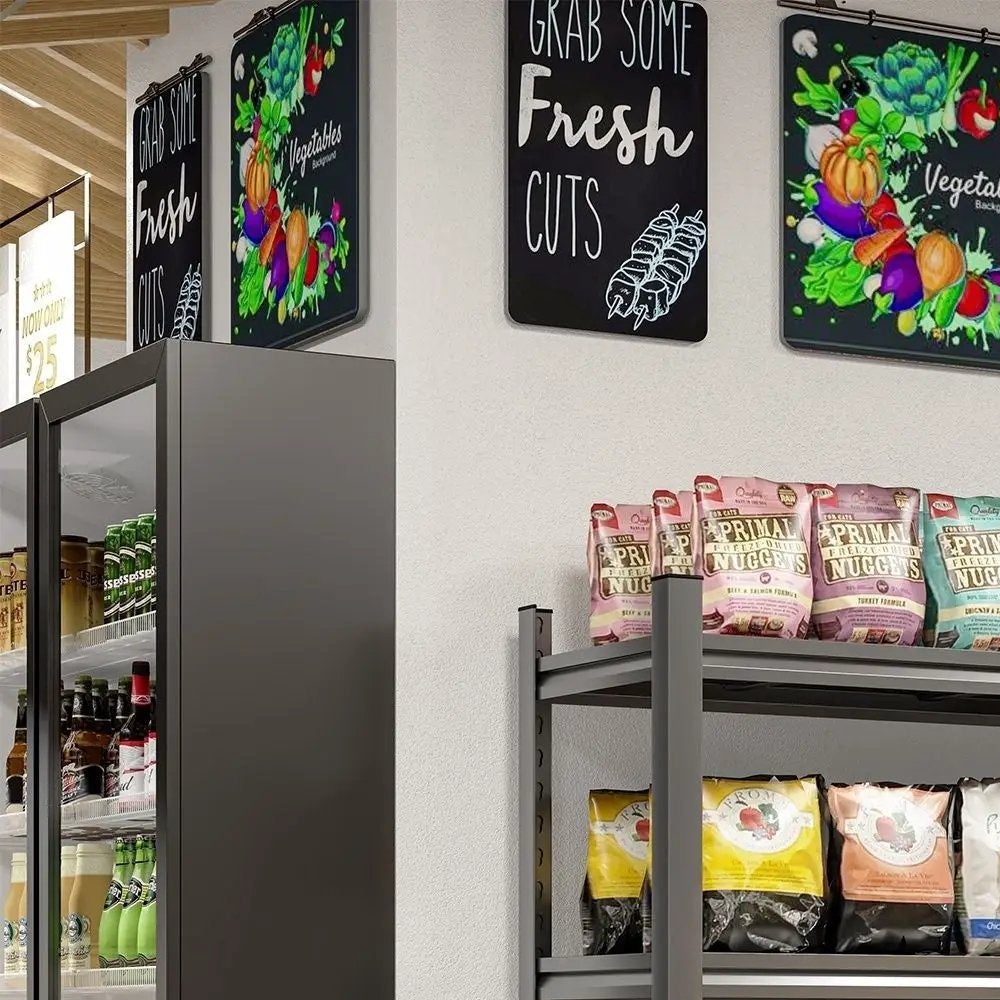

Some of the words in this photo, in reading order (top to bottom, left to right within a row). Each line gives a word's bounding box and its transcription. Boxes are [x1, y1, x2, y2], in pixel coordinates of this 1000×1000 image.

[529, 0, 601, 63] GRAB
[620, 0, 692, 76] SOME
[140, 96, 165, 172] GRAB
[170, 73, 198, 154] SOME
[516, 63, 693, 165] Fresh
[290, 118, 341, 178] Vegetables
[135, 162, 198, 258] Fresh
[526, 170, 601, 260] CUTS
[22, 310, 42, 338] NOW
[138, 265, 165, 347] CUTS
[613, 545, 651, 567] PRI
[718, 518, 797, 542] PRIMAL
[831, 523, 911, 546] PRIMAL
[712, 549, 807, 574] NUGGETS
[830, 556, 920, 580] NUGGETS
